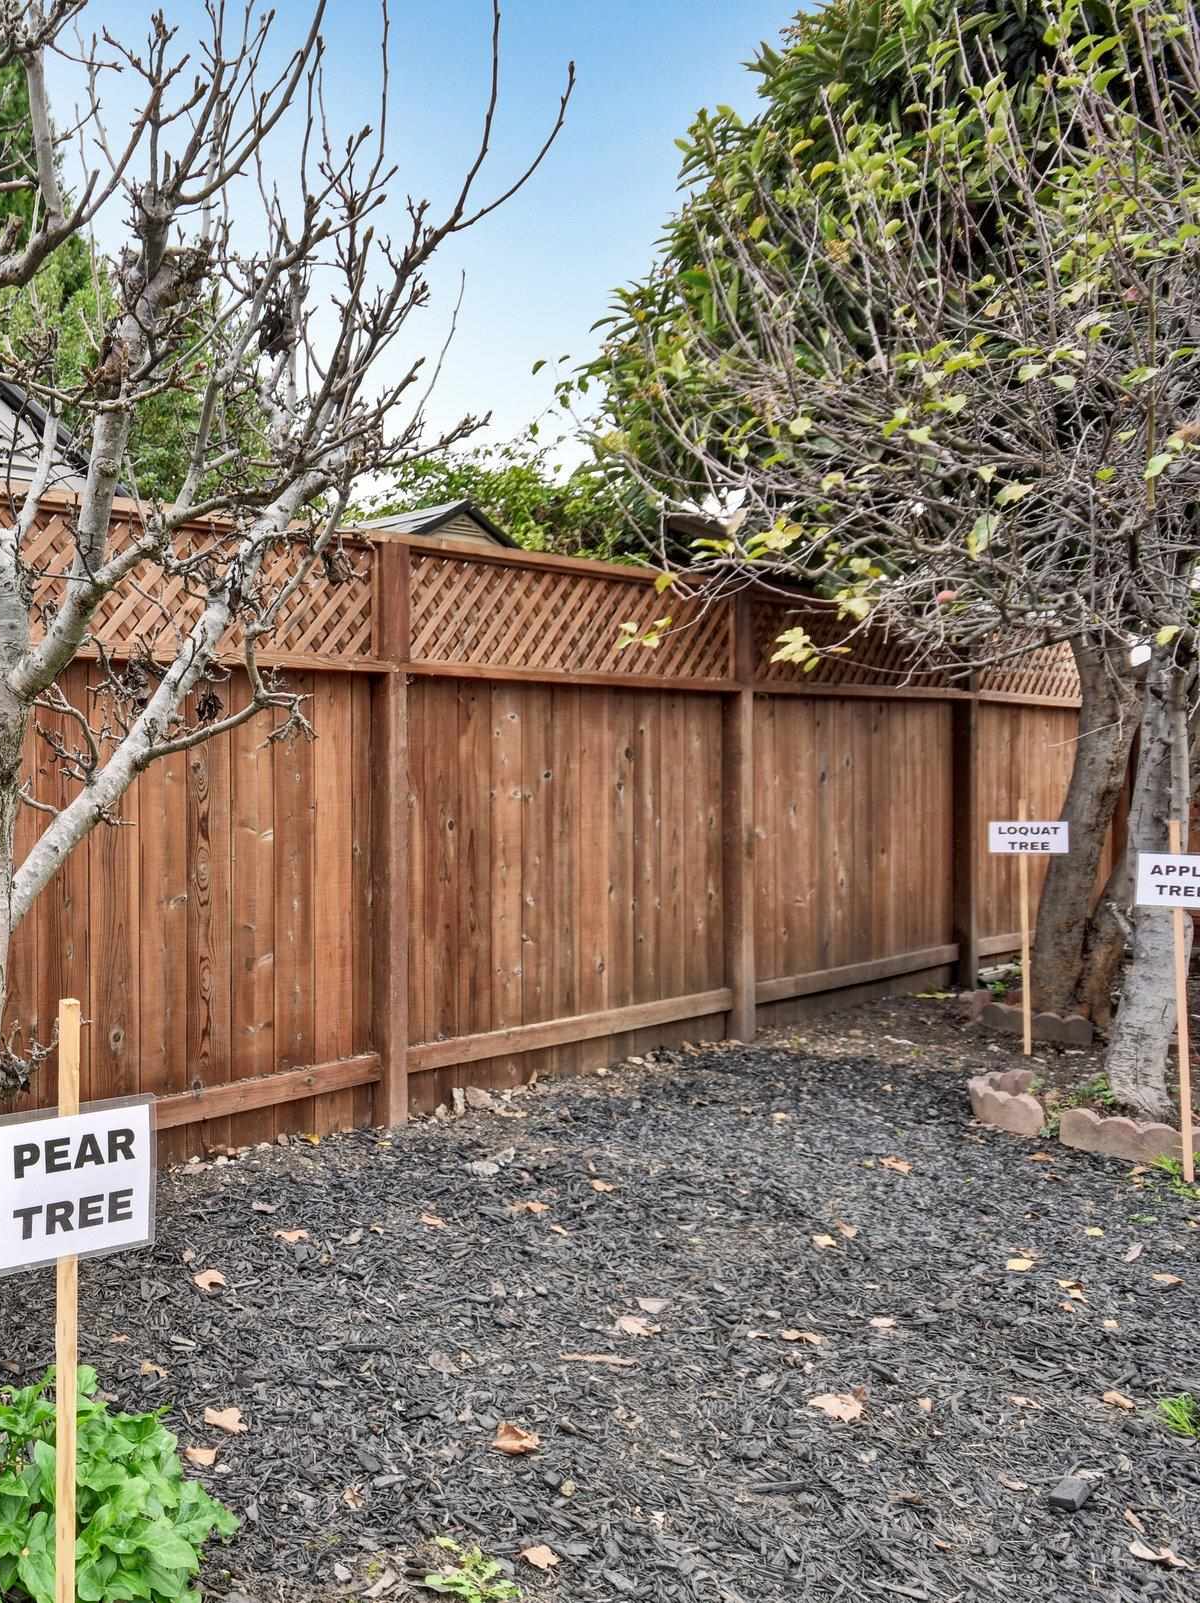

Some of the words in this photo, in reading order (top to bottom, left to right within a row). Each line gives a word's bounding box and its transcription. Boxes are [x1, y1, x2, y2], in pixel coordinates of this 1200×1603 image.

[998, 826, 1060, 836] LOQUAT
[1007, 841, 1050, 850] TREE
[1150, 864, 1200, 877] APPL
[1154, 884, 1200, 897] TRE
[13, 1128, 135, 1180] PEAR
[12, 1188, 134, 1240] TREE
